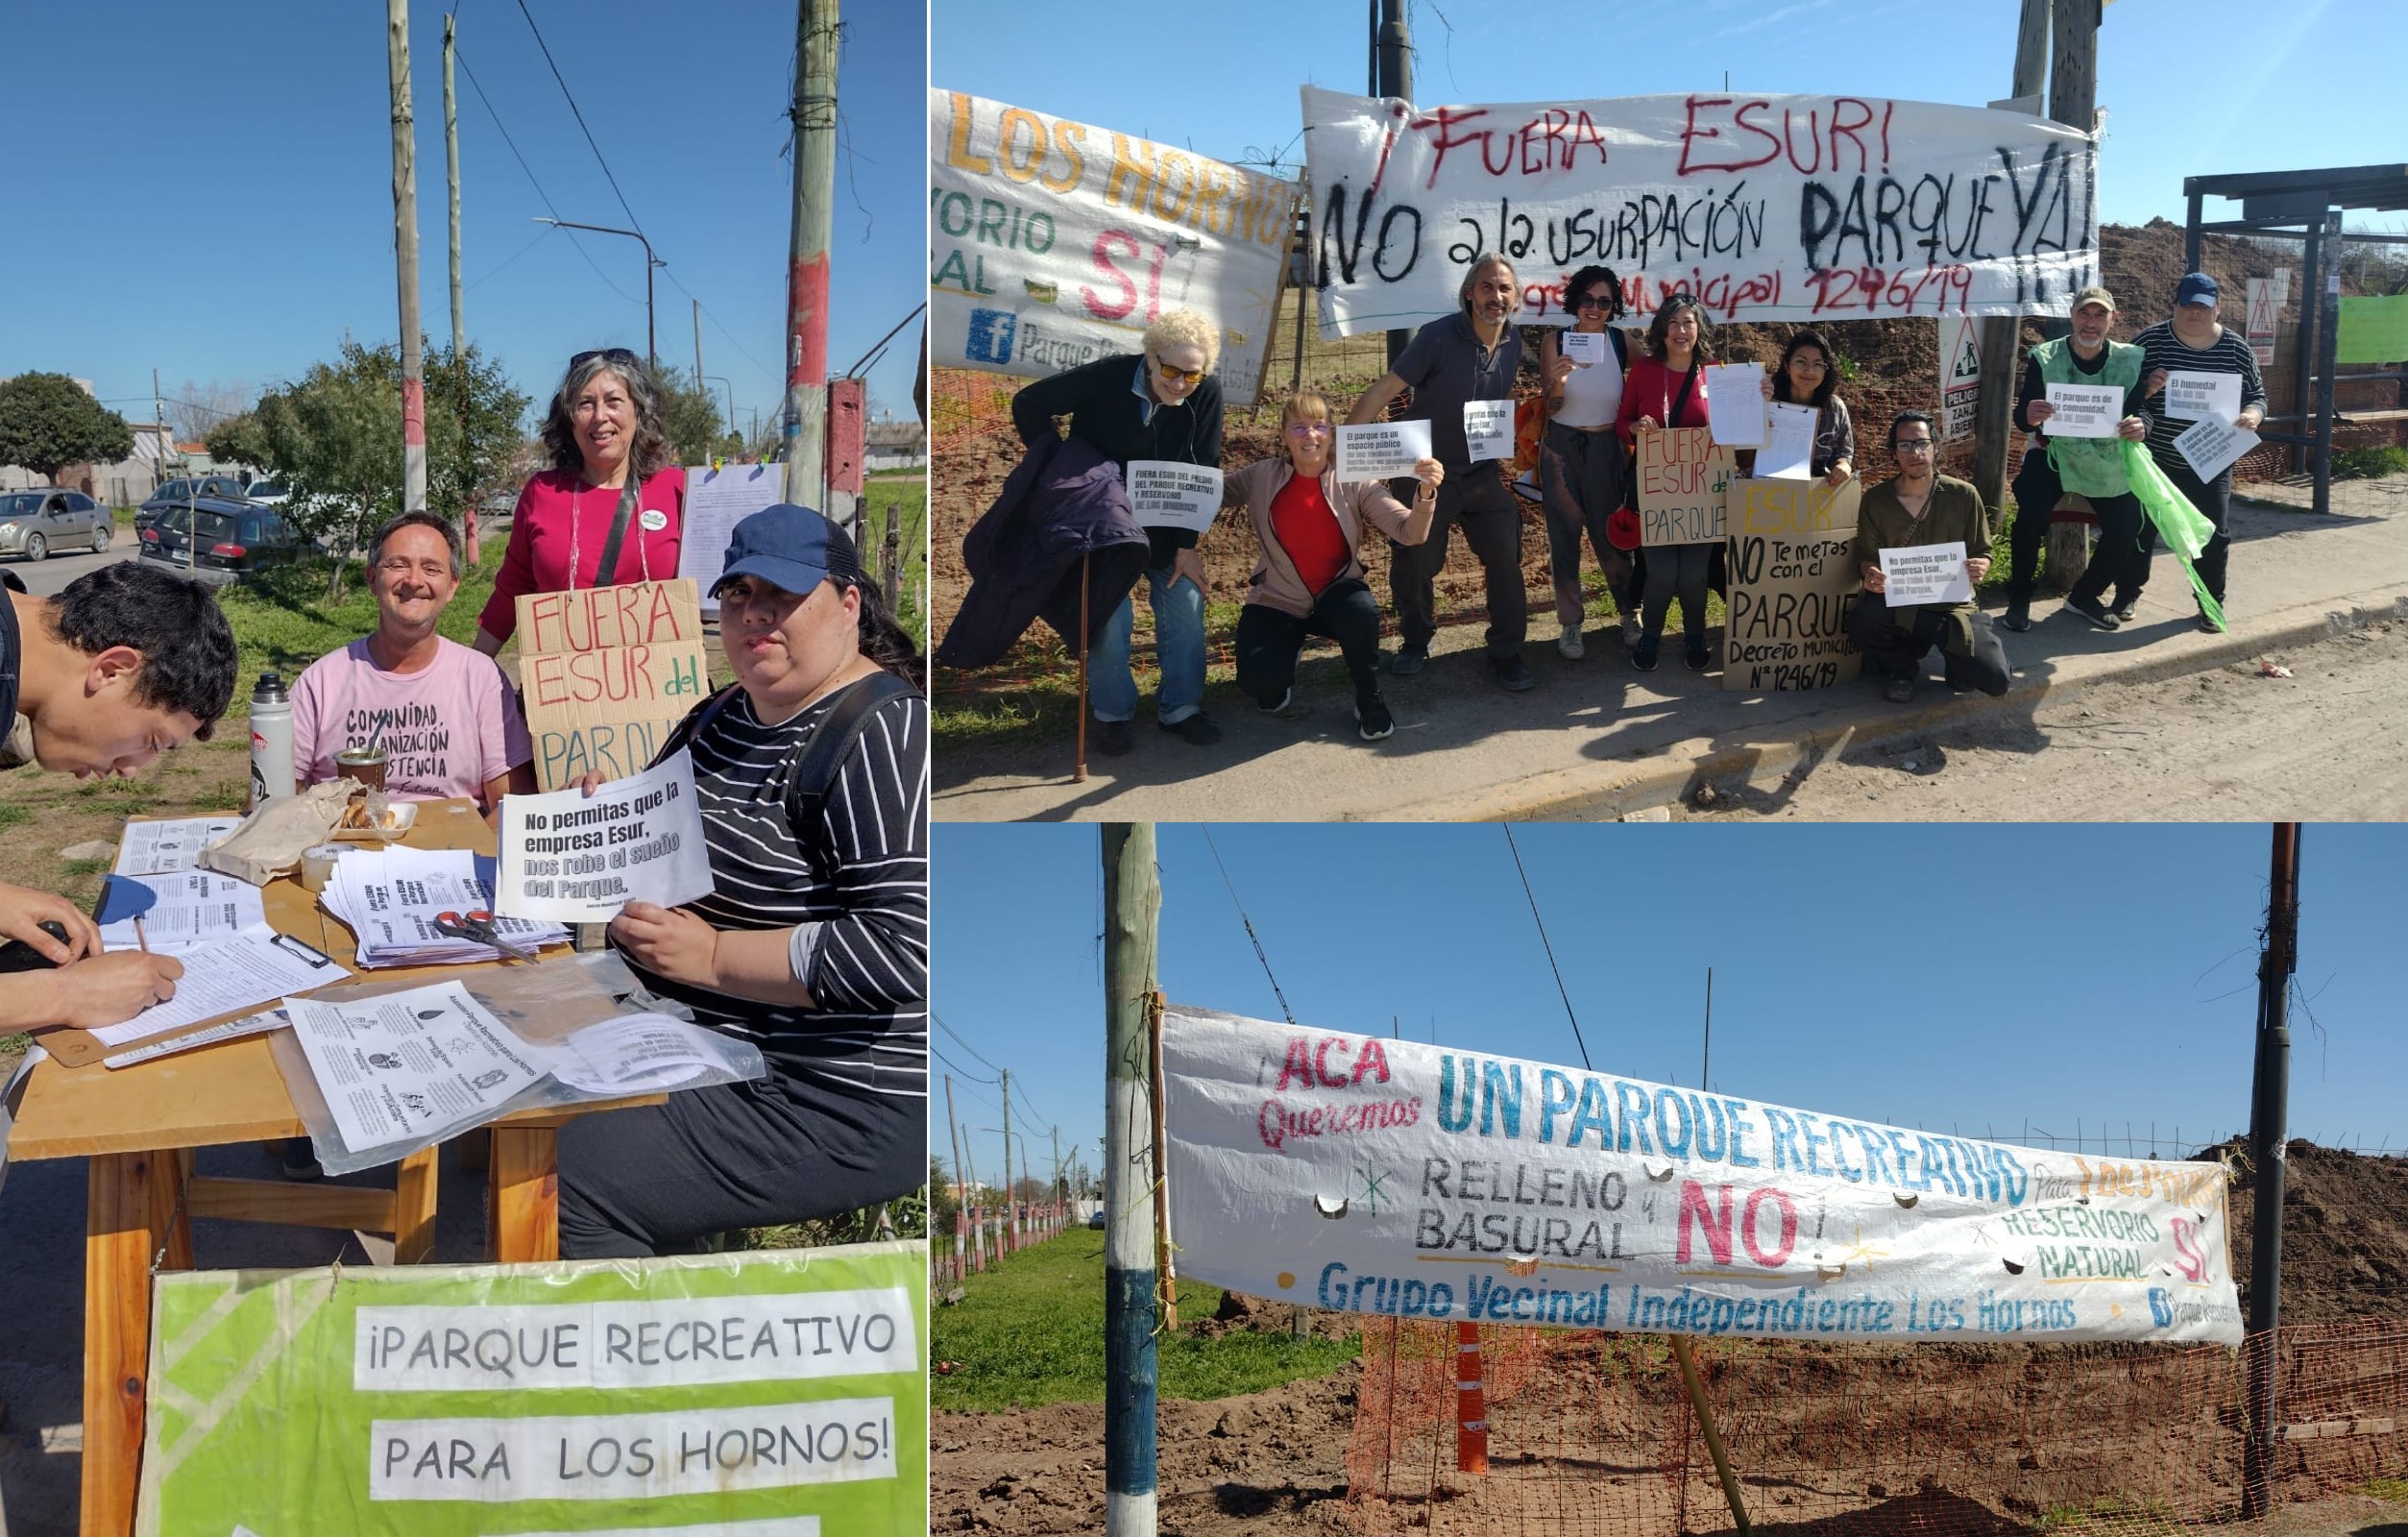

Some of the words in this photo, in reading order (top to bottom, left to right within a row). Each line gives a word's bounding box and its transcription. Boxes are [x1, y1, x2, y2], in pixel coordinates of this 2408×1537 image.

[1679, 95, 1893, 176] ESUR!
[945, 91, 1086, 193] LOS
[1106, 131, 1288, 250] HORNO
[1317, 183, 1422, 290] NO
[1448, 218, 1483, 265] a
[1801, 173, 2003, 273] PARQUE
[931, 247, 996, 295] AL
[1947, 386, 1979, 407] PELIGR
[2055, 392, 2062, 401] El
[2063, 392, 2090, 403] parque
[2103, 395, 2112, 403] de
[2180, 380, 2216, 391] humedal
[2062, 403, 2107, 415] comunidad,
[1354, 432, 1378, 441] parque
[1375, 440, 1401, 450] público
[1645, 427, 1723, 464] FUERA
[1135, 470, 1156, 478] FUERA
[1178, 482, 1214, 495] RECREATIVO
[1644, 462, 1707, 495] ESUR
[1644, 506, 1726, 543] PARQUE
[1744, 486, 1835, 533] ESUR
[1728, 536, 1765, 585] NO
[1769, 563, 1803, 578] con
[1808, 559, 1823, 576] el
[1890, 567, 1923, 576] empresa
[1900, 555, 1933, 567] permitas
[532, 583, 681, 652] FUERA
[1732, 591, 1859, 640] PARQUE
[538, 646, 656, 707] ESUR
[665, 654, 700, 697] del
[1774, 662, 1837, 692] 1246/19
[347, 726, 449, 755] ORANIZACIÓN
[542, 720, 678, 790] PARQU
[524, 814, 547, 830] No
[552, 801, 630, 832] permitas
[634, 793, 664, 817] que
[667, 780, 679, 802] la
[524, 831, 603, 855] empresa
[608, 821, 650, 845] Esur,
[524, 859, 559, 876] nos
[563, 854, 605, 875] robe
[609, 847, 627, 869] el
[630, 831, 680, 865] sueño
[524, 880, 554, 898] del
[558, 876, 628, 900] Parque.
[1258, 1097, 1423, 1154] Queremos
[1437, 1055, 1523, 1139] UN
[1538, 1068, 1760, 1168] PARQUE
[1765, 1107, 2028, 1208] RECREATIVO
[1421, 1157, 1628, 1211] RELLENO
[1415, 1208, 1634, 1260] BASURAL
[1675, 1179, 1798, 1268] NO
[2002, 1207, 2160, 1243] RESERVORIO
[2036, 1244, 2149, 1281] NATURAL
[1318, 1262, 1453, 1318] Grupo
[1469, 1273, 1609, 1327] Vecinal
[1627, 1282, 1905, 1336] Independiente
[1909, 1289, 1965, 1333] Los
[1978, 1288, 2078, 1332] Hornos
[369, 1322, 580, 1380] ¡PARQUE
[605, 1312, 896, 1366] RECREATIVO
[384, 1437, 512, 1483] PARA
[558, 1435, 654, 1481] LOS
[679, 1416, 890, 1475] HORNOS!
